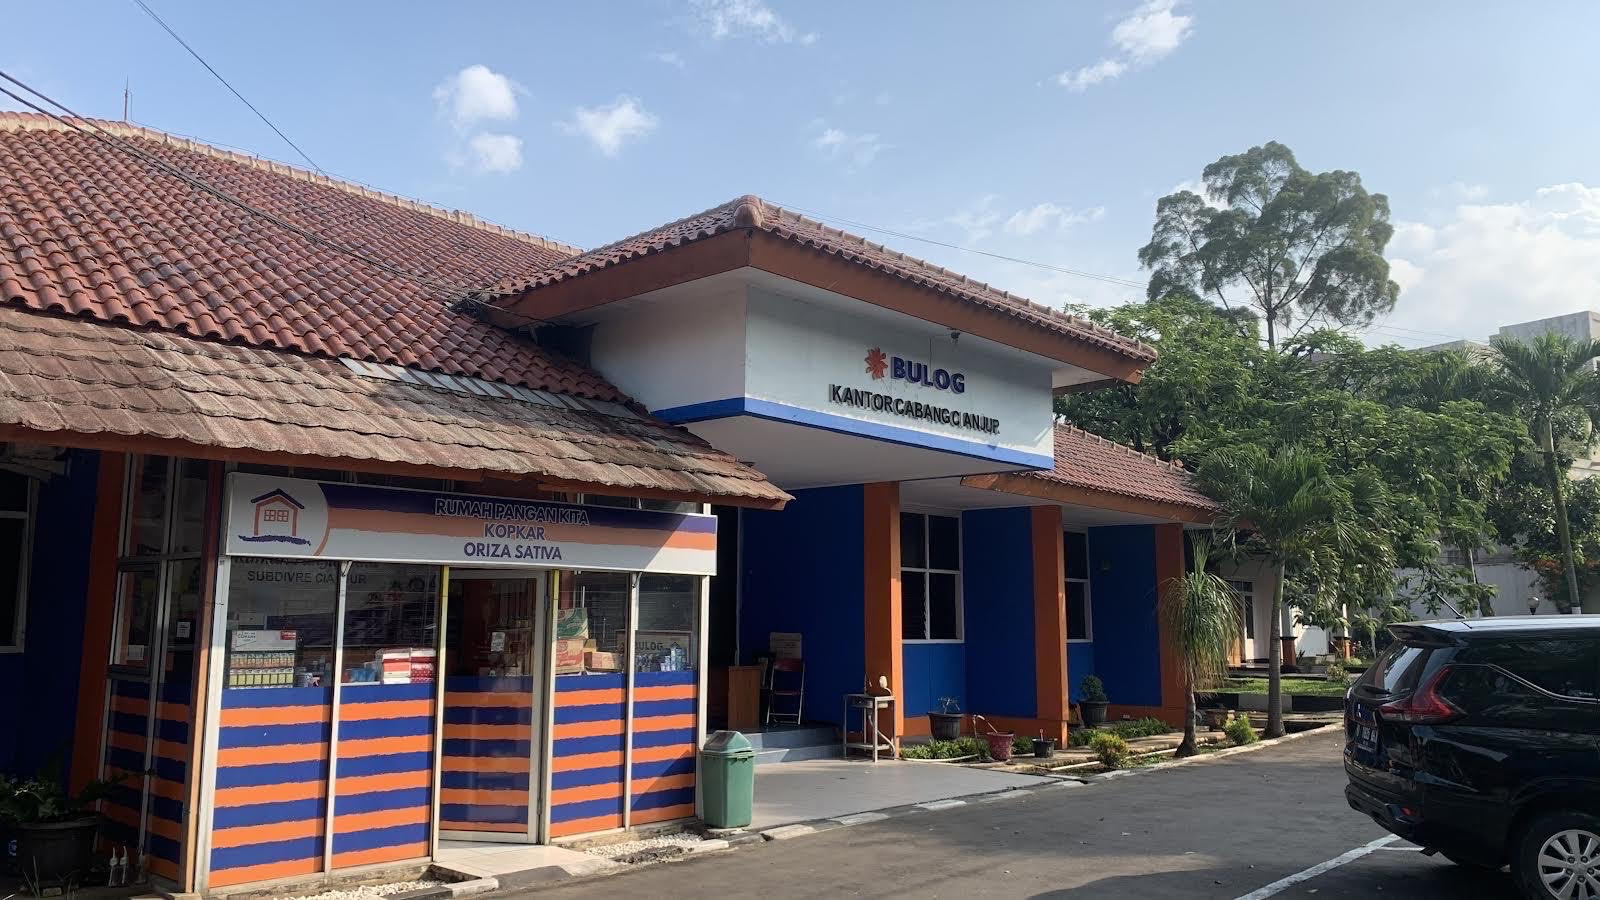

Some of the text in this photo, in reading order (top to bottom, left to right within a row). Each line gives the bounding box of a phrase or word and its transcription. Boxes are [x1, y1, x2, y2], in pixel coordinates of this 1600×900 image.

[890, 356, 966, 395] BULOG
[829, 383, 893, 413] KANTOR
[893, 398, 951, 425] CABANG
[435, 498, 590, 525] RUMAH PANGAN KITA
[484, 523, 546, 541] KOPKAR
[463, 541, 563, 561] ORIZA SATIVA
[247, 570, 367, 584] SUBDIVRE CIAUR
